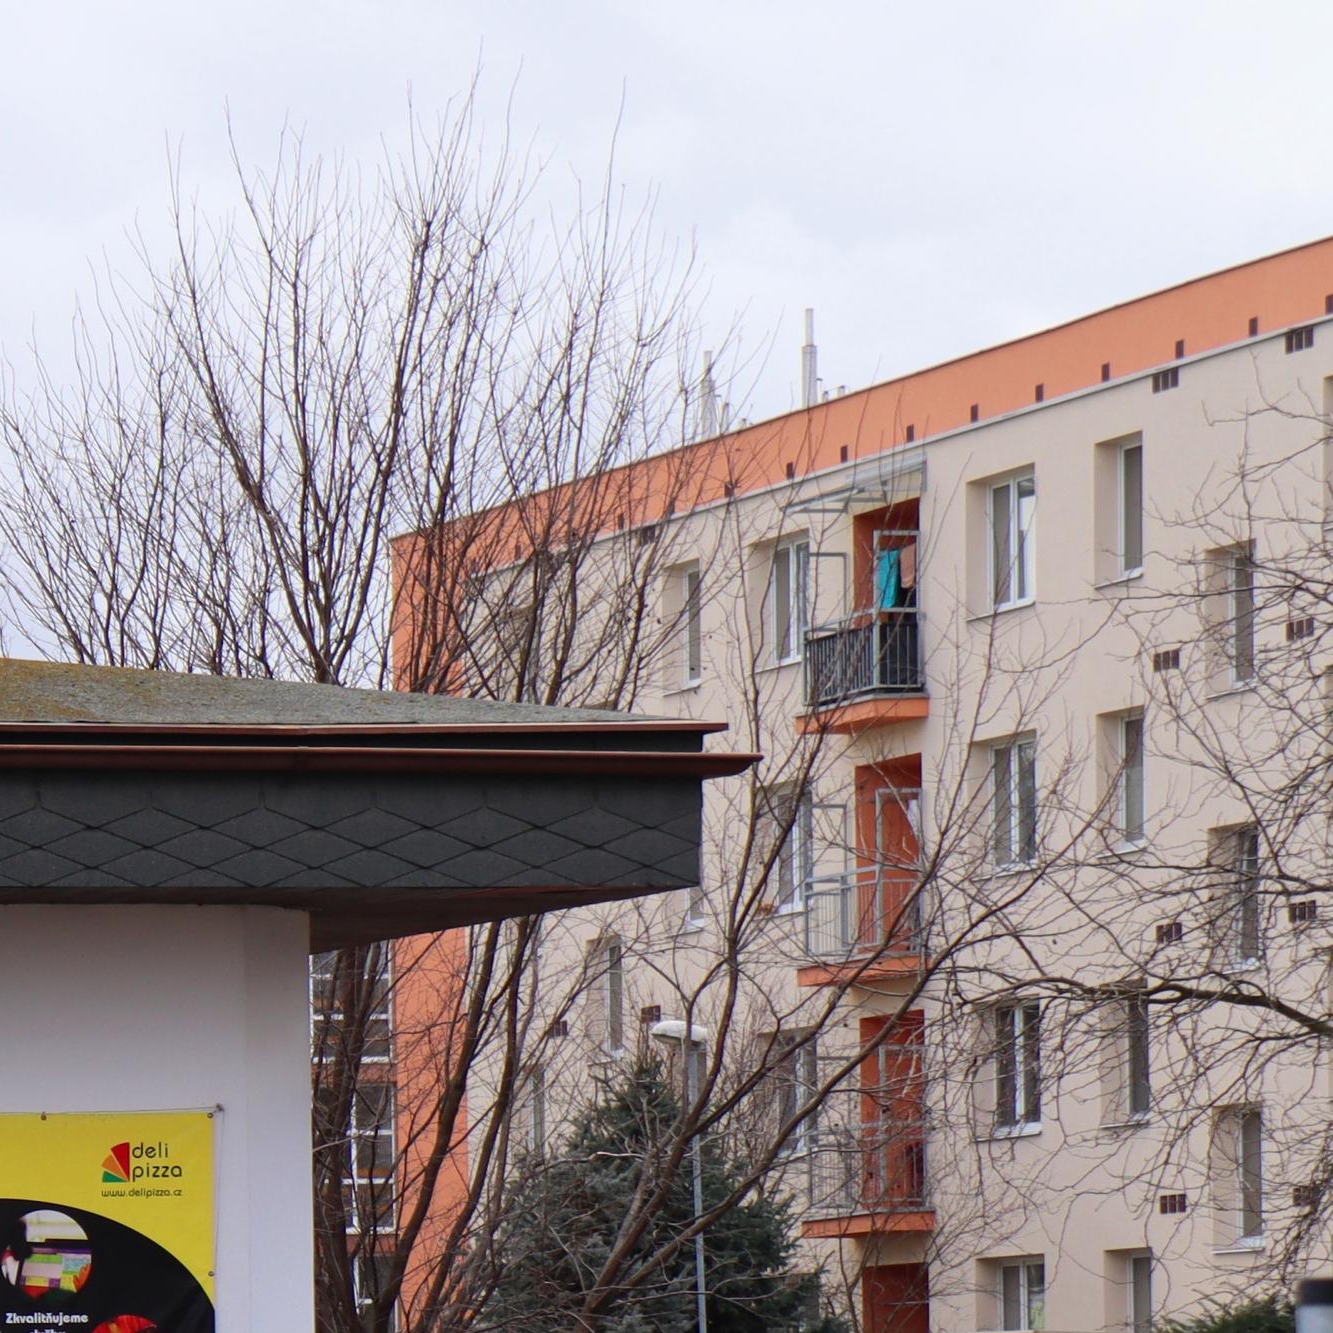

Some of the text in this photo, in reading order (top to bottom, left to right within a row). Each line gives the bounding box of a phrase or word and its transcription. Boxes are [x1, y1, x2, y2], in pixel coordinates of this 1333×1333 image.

[132, 1142, 168, 1158] deli
[133, 1163, 182, 1182] pizza
[101, 1189, 181, 1198] www.delipizza.cz
[5, 1312, 88, 1326] Zkvalitňujeme
